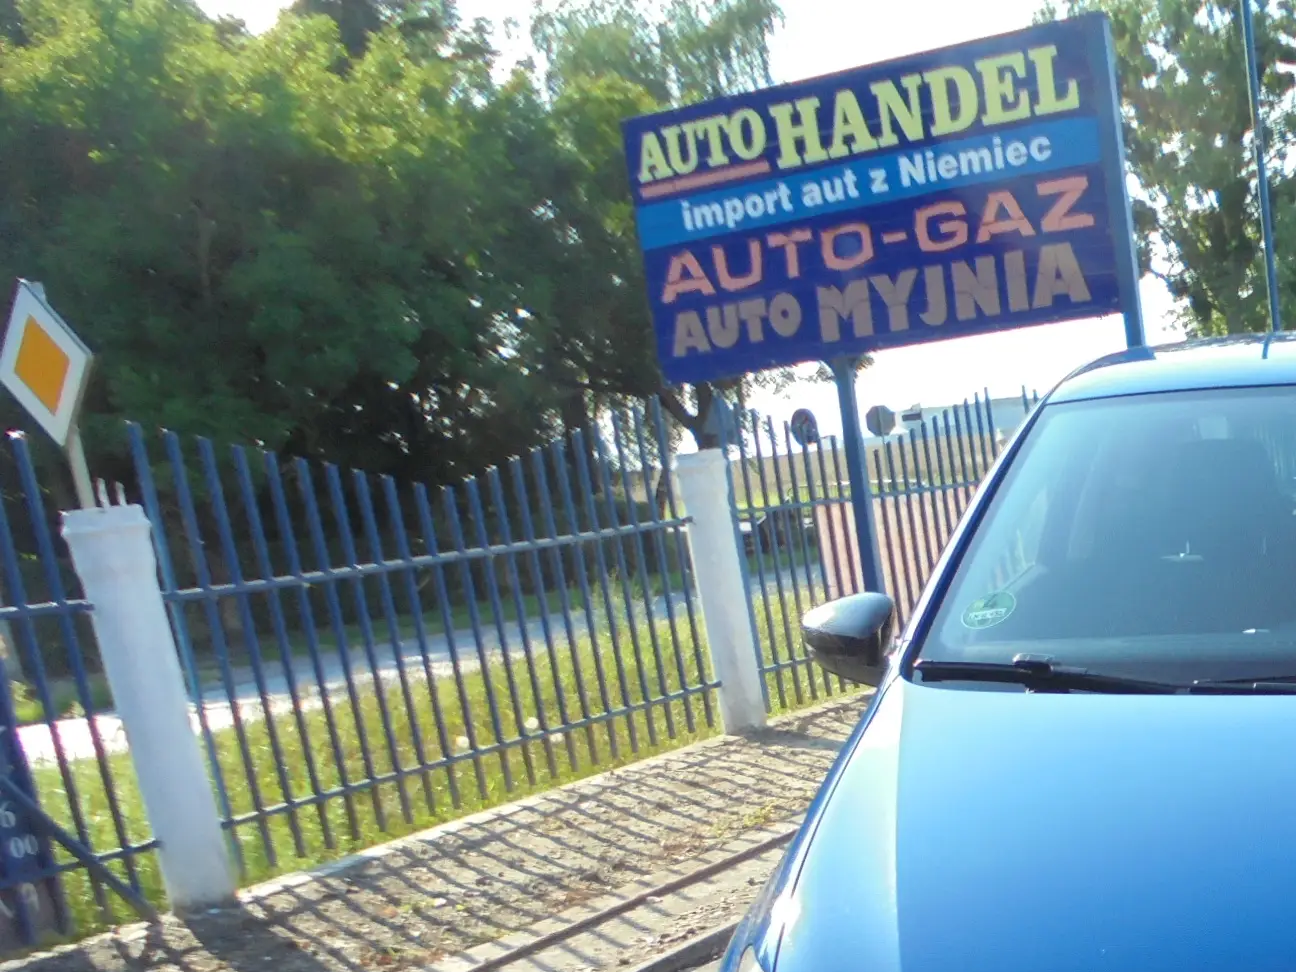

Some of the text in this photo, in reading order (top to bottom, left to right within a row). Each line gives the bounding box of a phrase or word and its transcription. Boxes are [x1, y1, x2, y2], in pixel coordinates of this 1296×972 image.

[637, 44, 1080, 184] AUTO HANDEL
[662, 176, 1095, 303] AUTO-GAZ
[682, 132, 1052, 232] import aut z Niemiec
[673, 242, 1092, 357] AUTO MYJNIA
